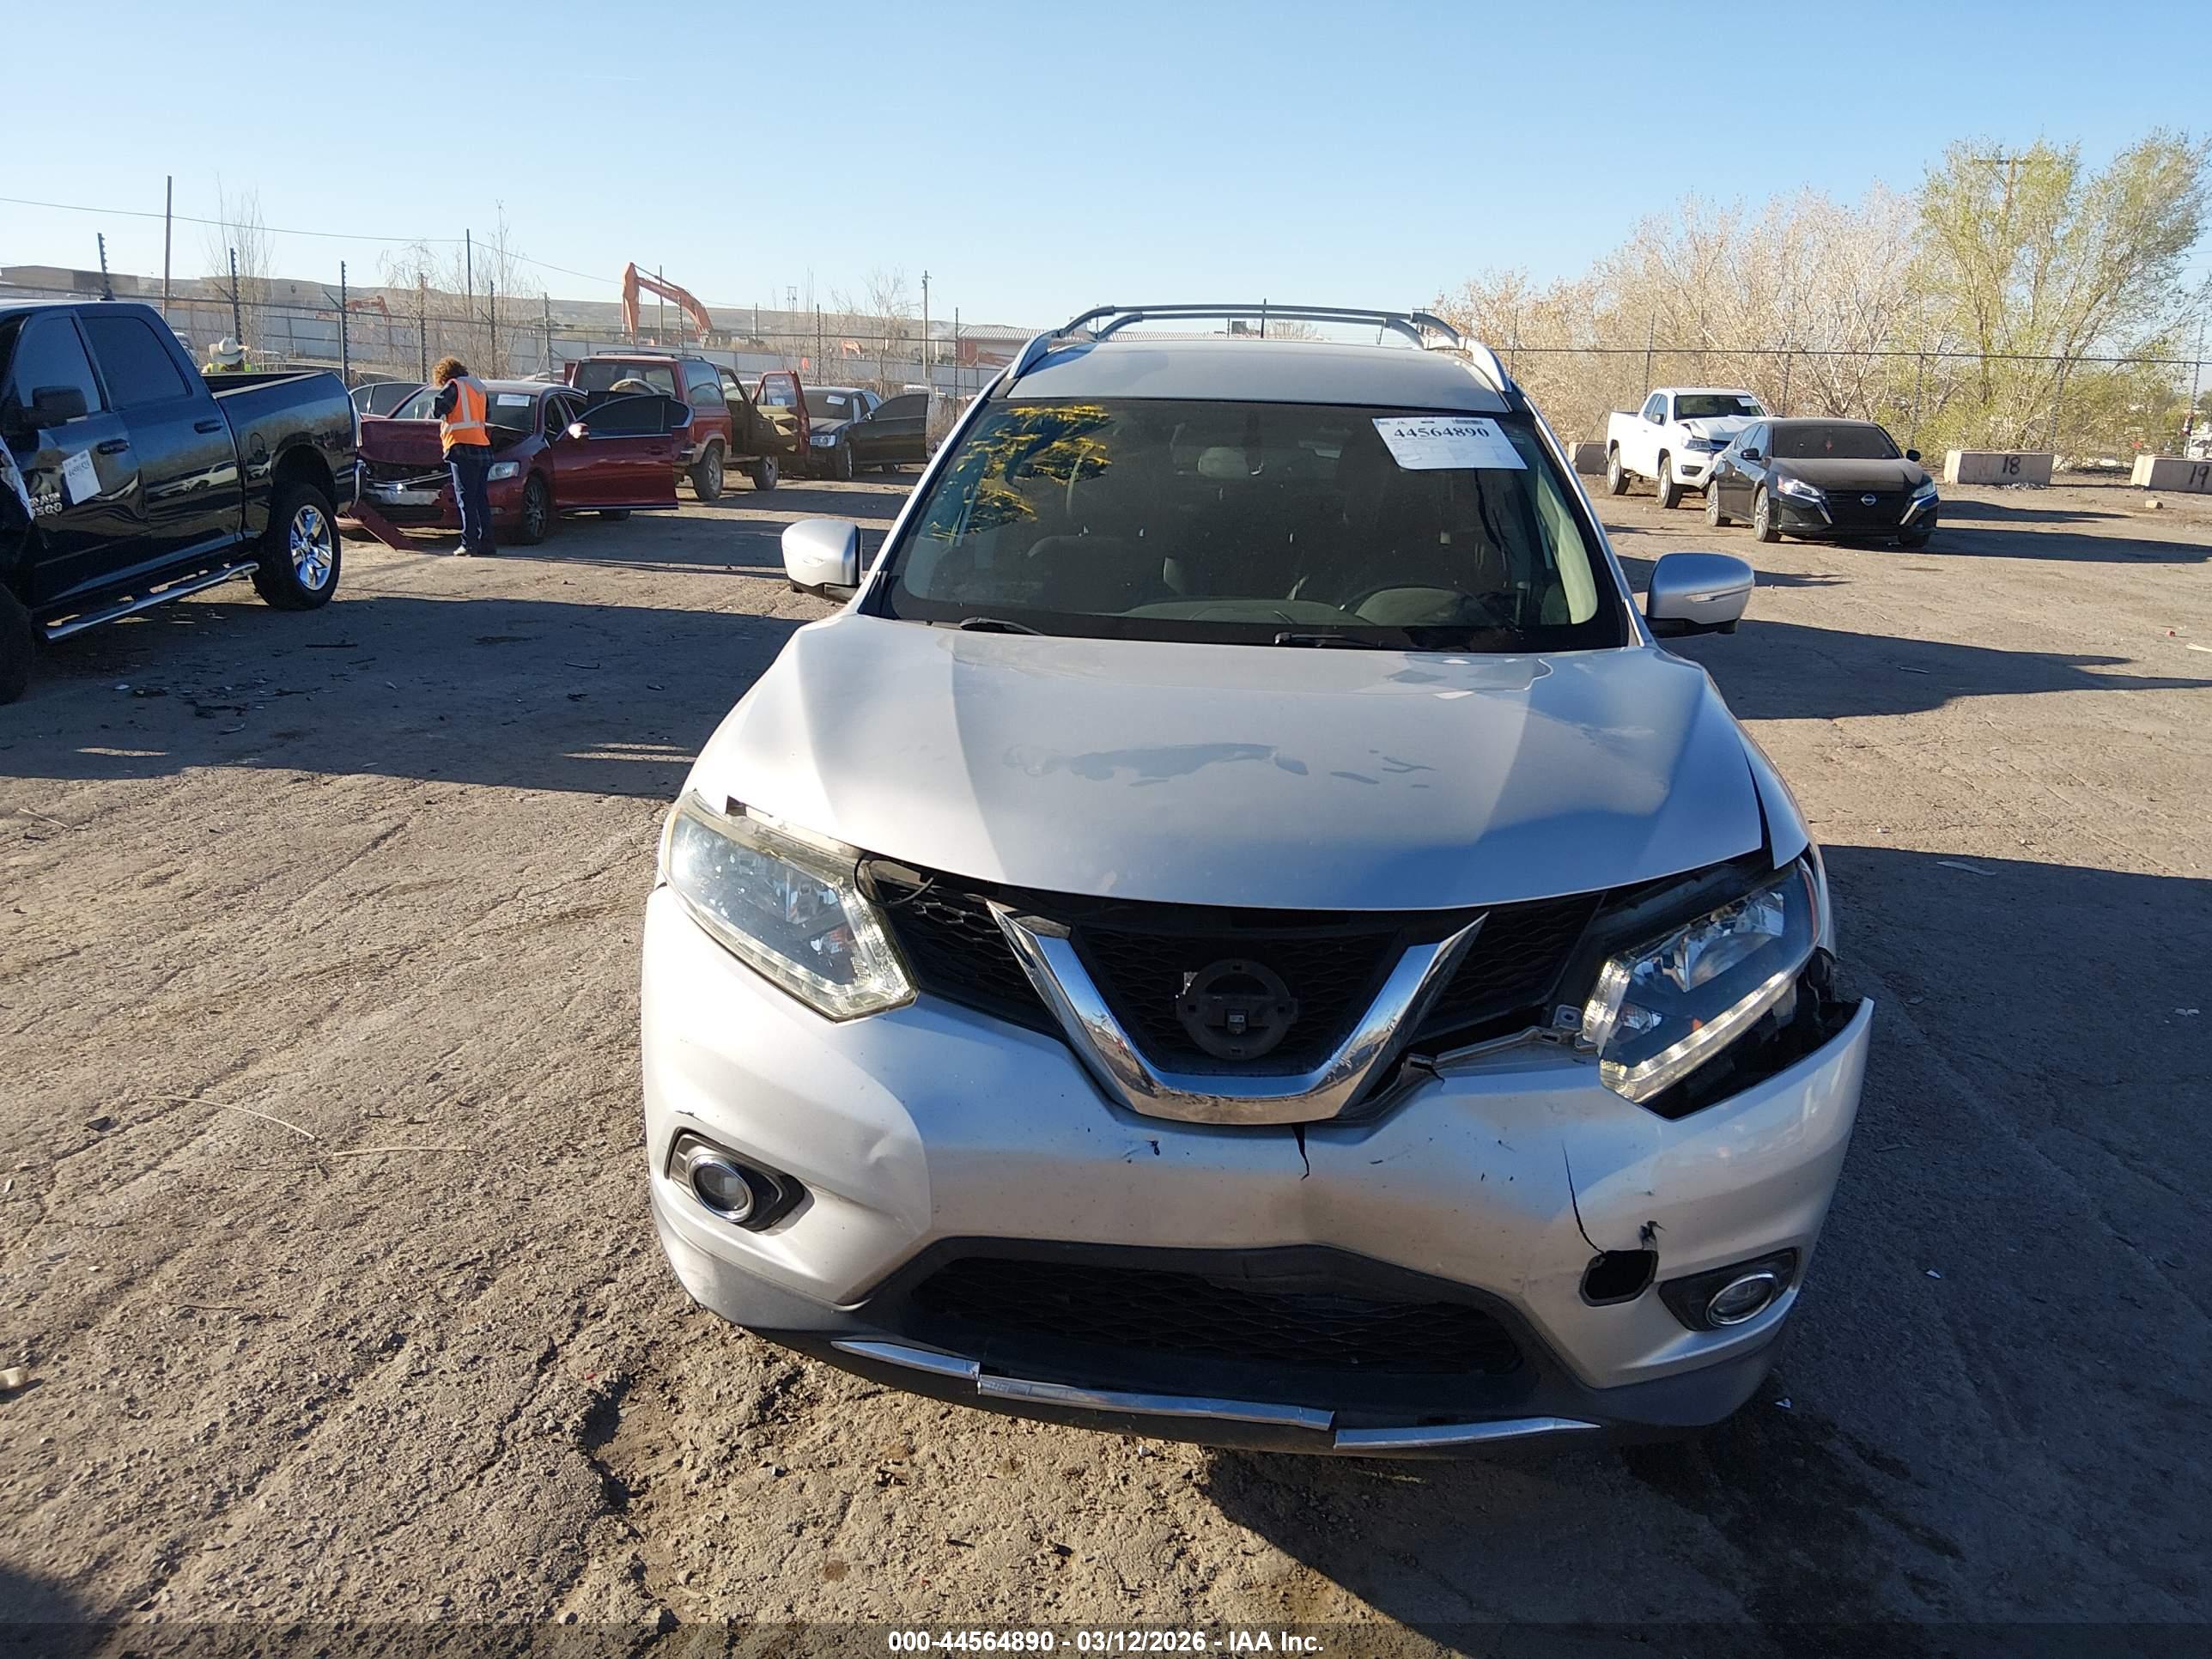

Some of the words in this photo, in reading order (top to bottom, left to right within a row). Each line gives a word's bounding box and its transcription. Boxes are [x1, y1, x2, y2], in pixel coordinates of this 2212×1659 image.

[1394, 427, 1490, 438] 44564890
[2002, 455, 2021, 475] 18
[2189, 464, 2210, 489] 19
